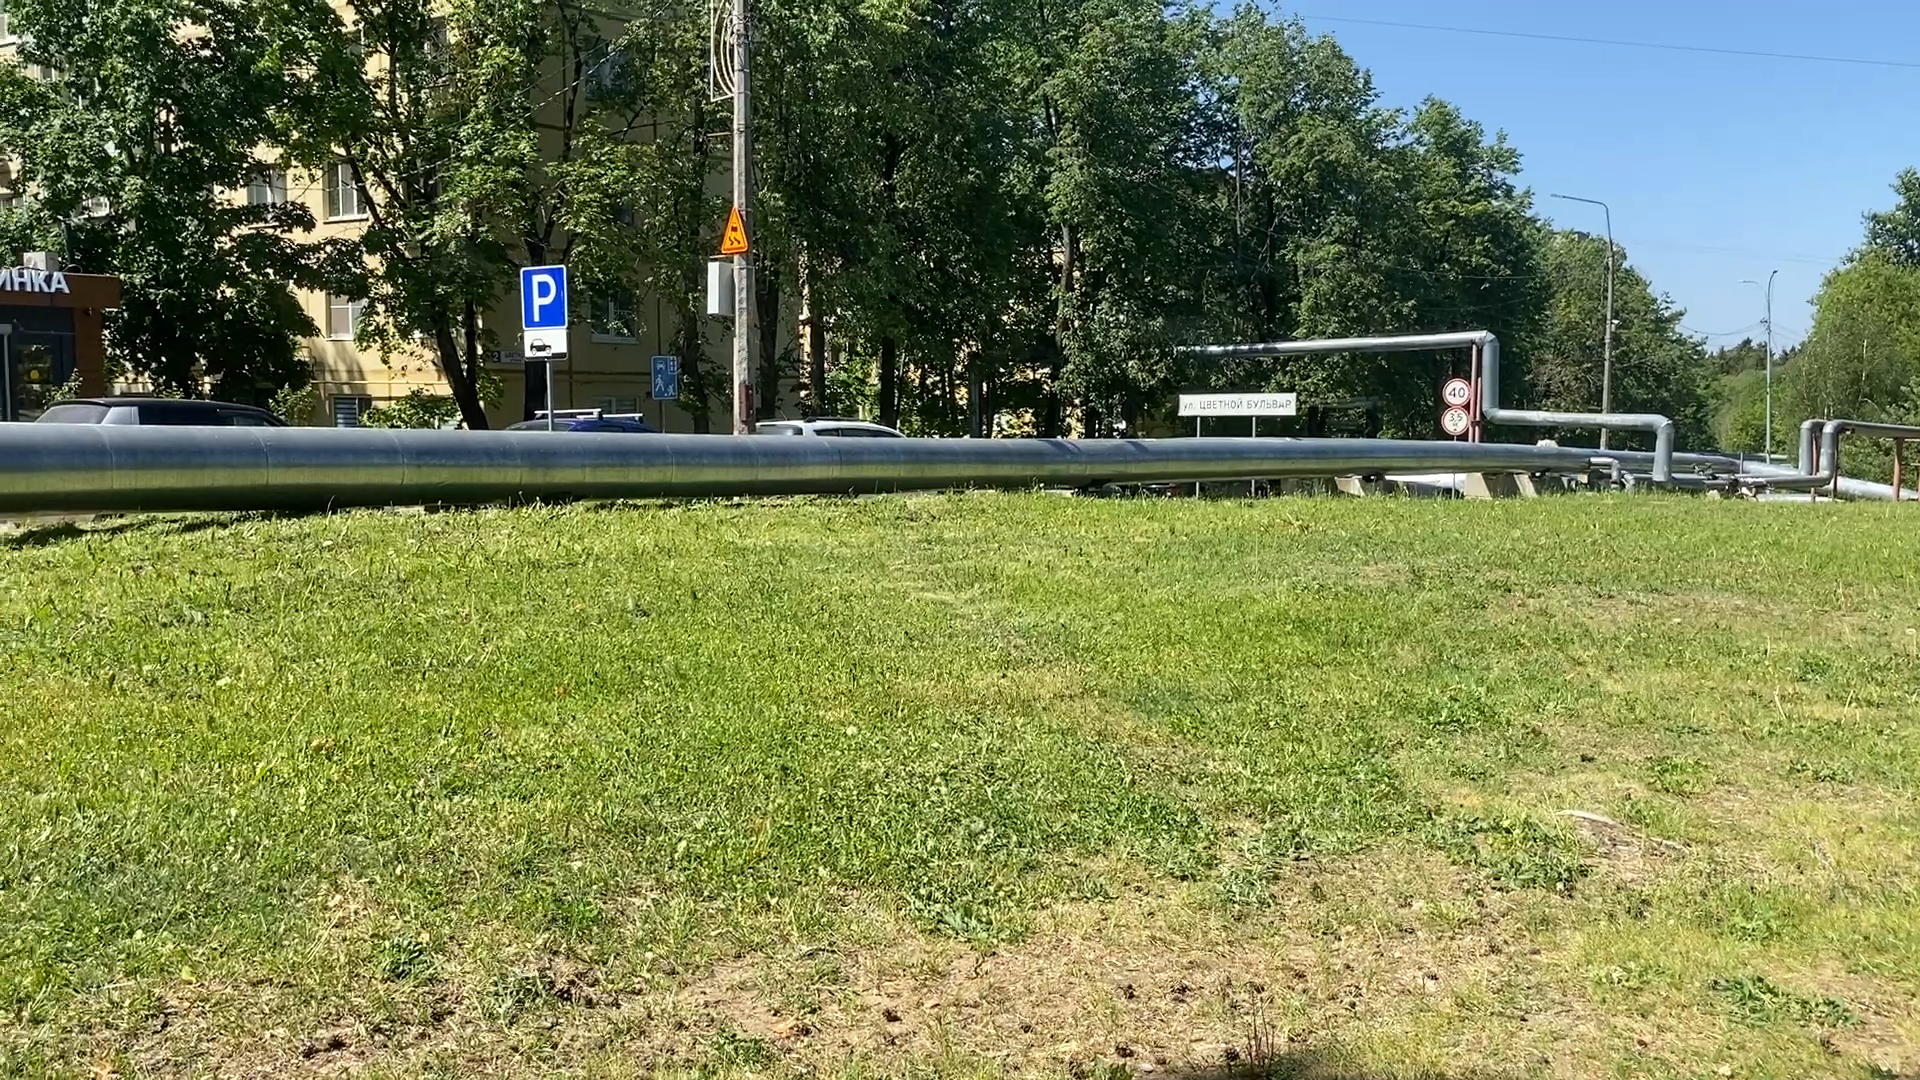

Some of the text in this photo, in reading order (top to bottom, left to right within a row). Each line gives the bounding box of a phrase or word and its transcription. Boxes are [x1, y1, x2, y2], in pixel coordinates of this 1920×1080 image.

[532, 274, 557, 322] P
[1448, 387, 1465, 398] 40
[1183, 399, 1292, 411] ул. ЦВЕТНОЙ БУЛЬВАР
